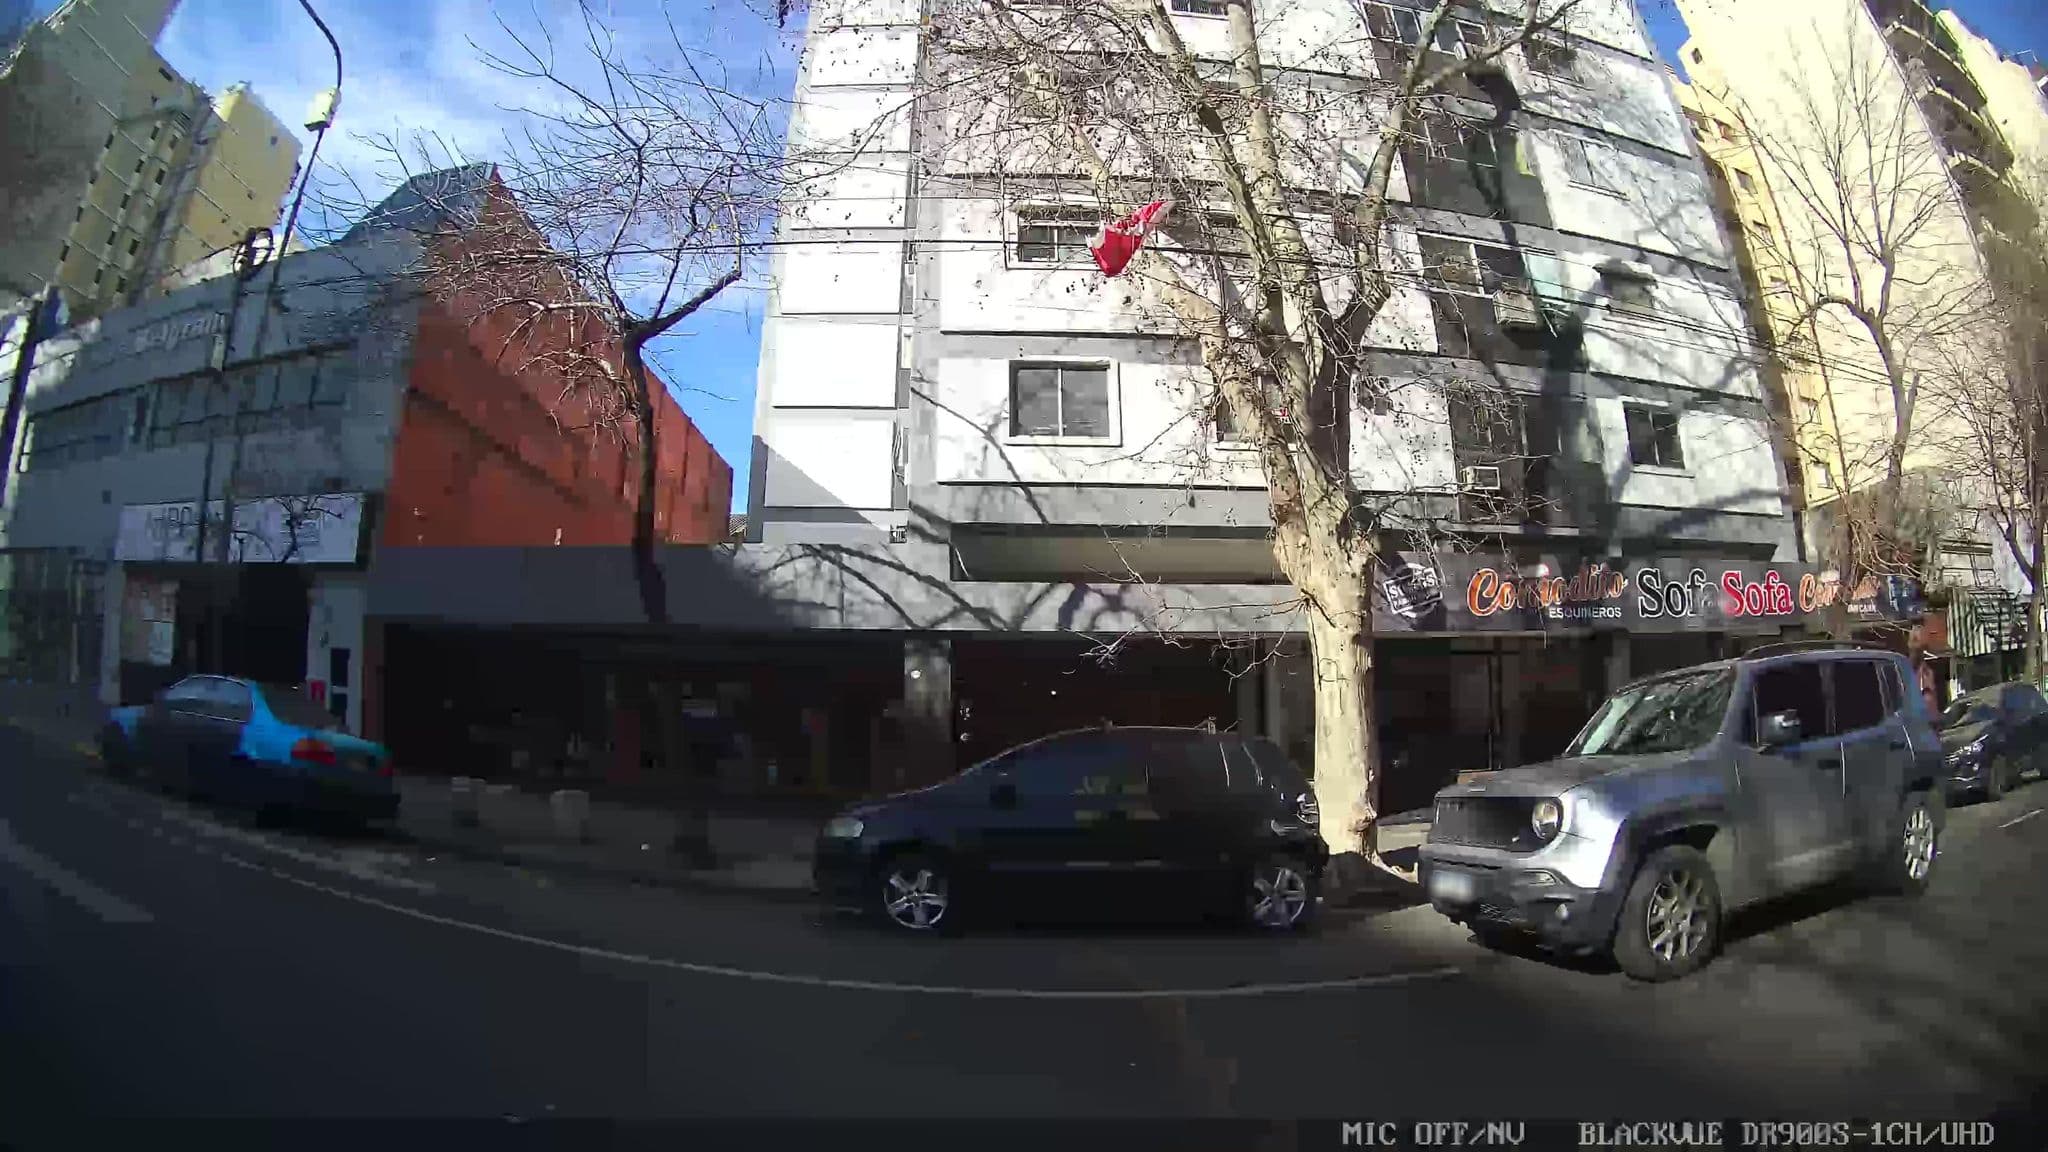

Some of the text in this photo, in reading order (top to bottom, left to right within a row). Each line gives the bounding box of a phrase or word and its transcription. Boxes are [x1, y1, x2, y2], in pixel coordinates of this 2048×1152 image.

[1636, 568, 1795, 617] Sofa Sofa
[1549, 607, 1622, 618] ESQUINEROS
